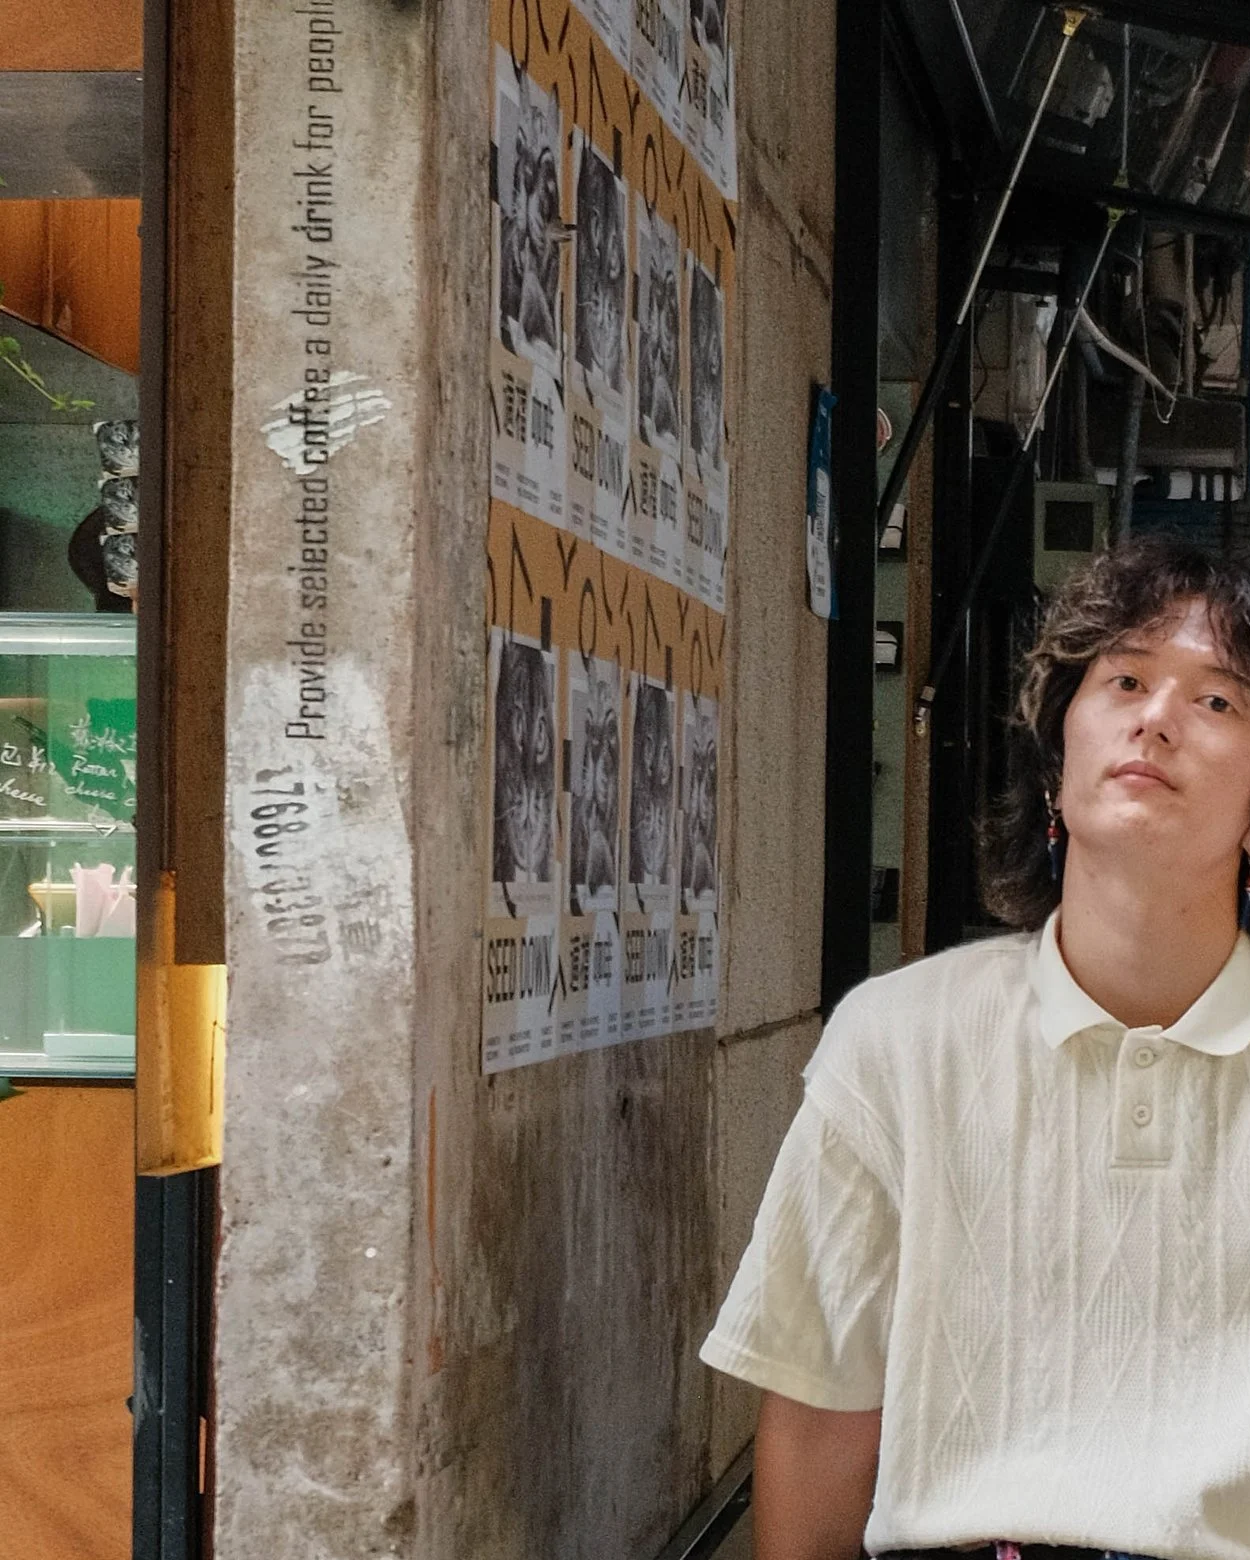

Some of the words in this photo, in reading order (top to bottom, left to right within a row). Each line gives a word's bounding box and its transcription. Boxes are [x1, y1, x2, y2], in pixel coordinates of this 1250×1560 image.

[295, 0, 343, 92] peopl
[293, 104, 334, 149] for
[291, 163, 333, 243] drink
[291, 254, 341, 326] daily
[305, 339, 331, 355] a
[289, 367, 331, 466] coffee
[285, 621, 326, 740] Provide
[487, 937, 517, 1004] SEED
